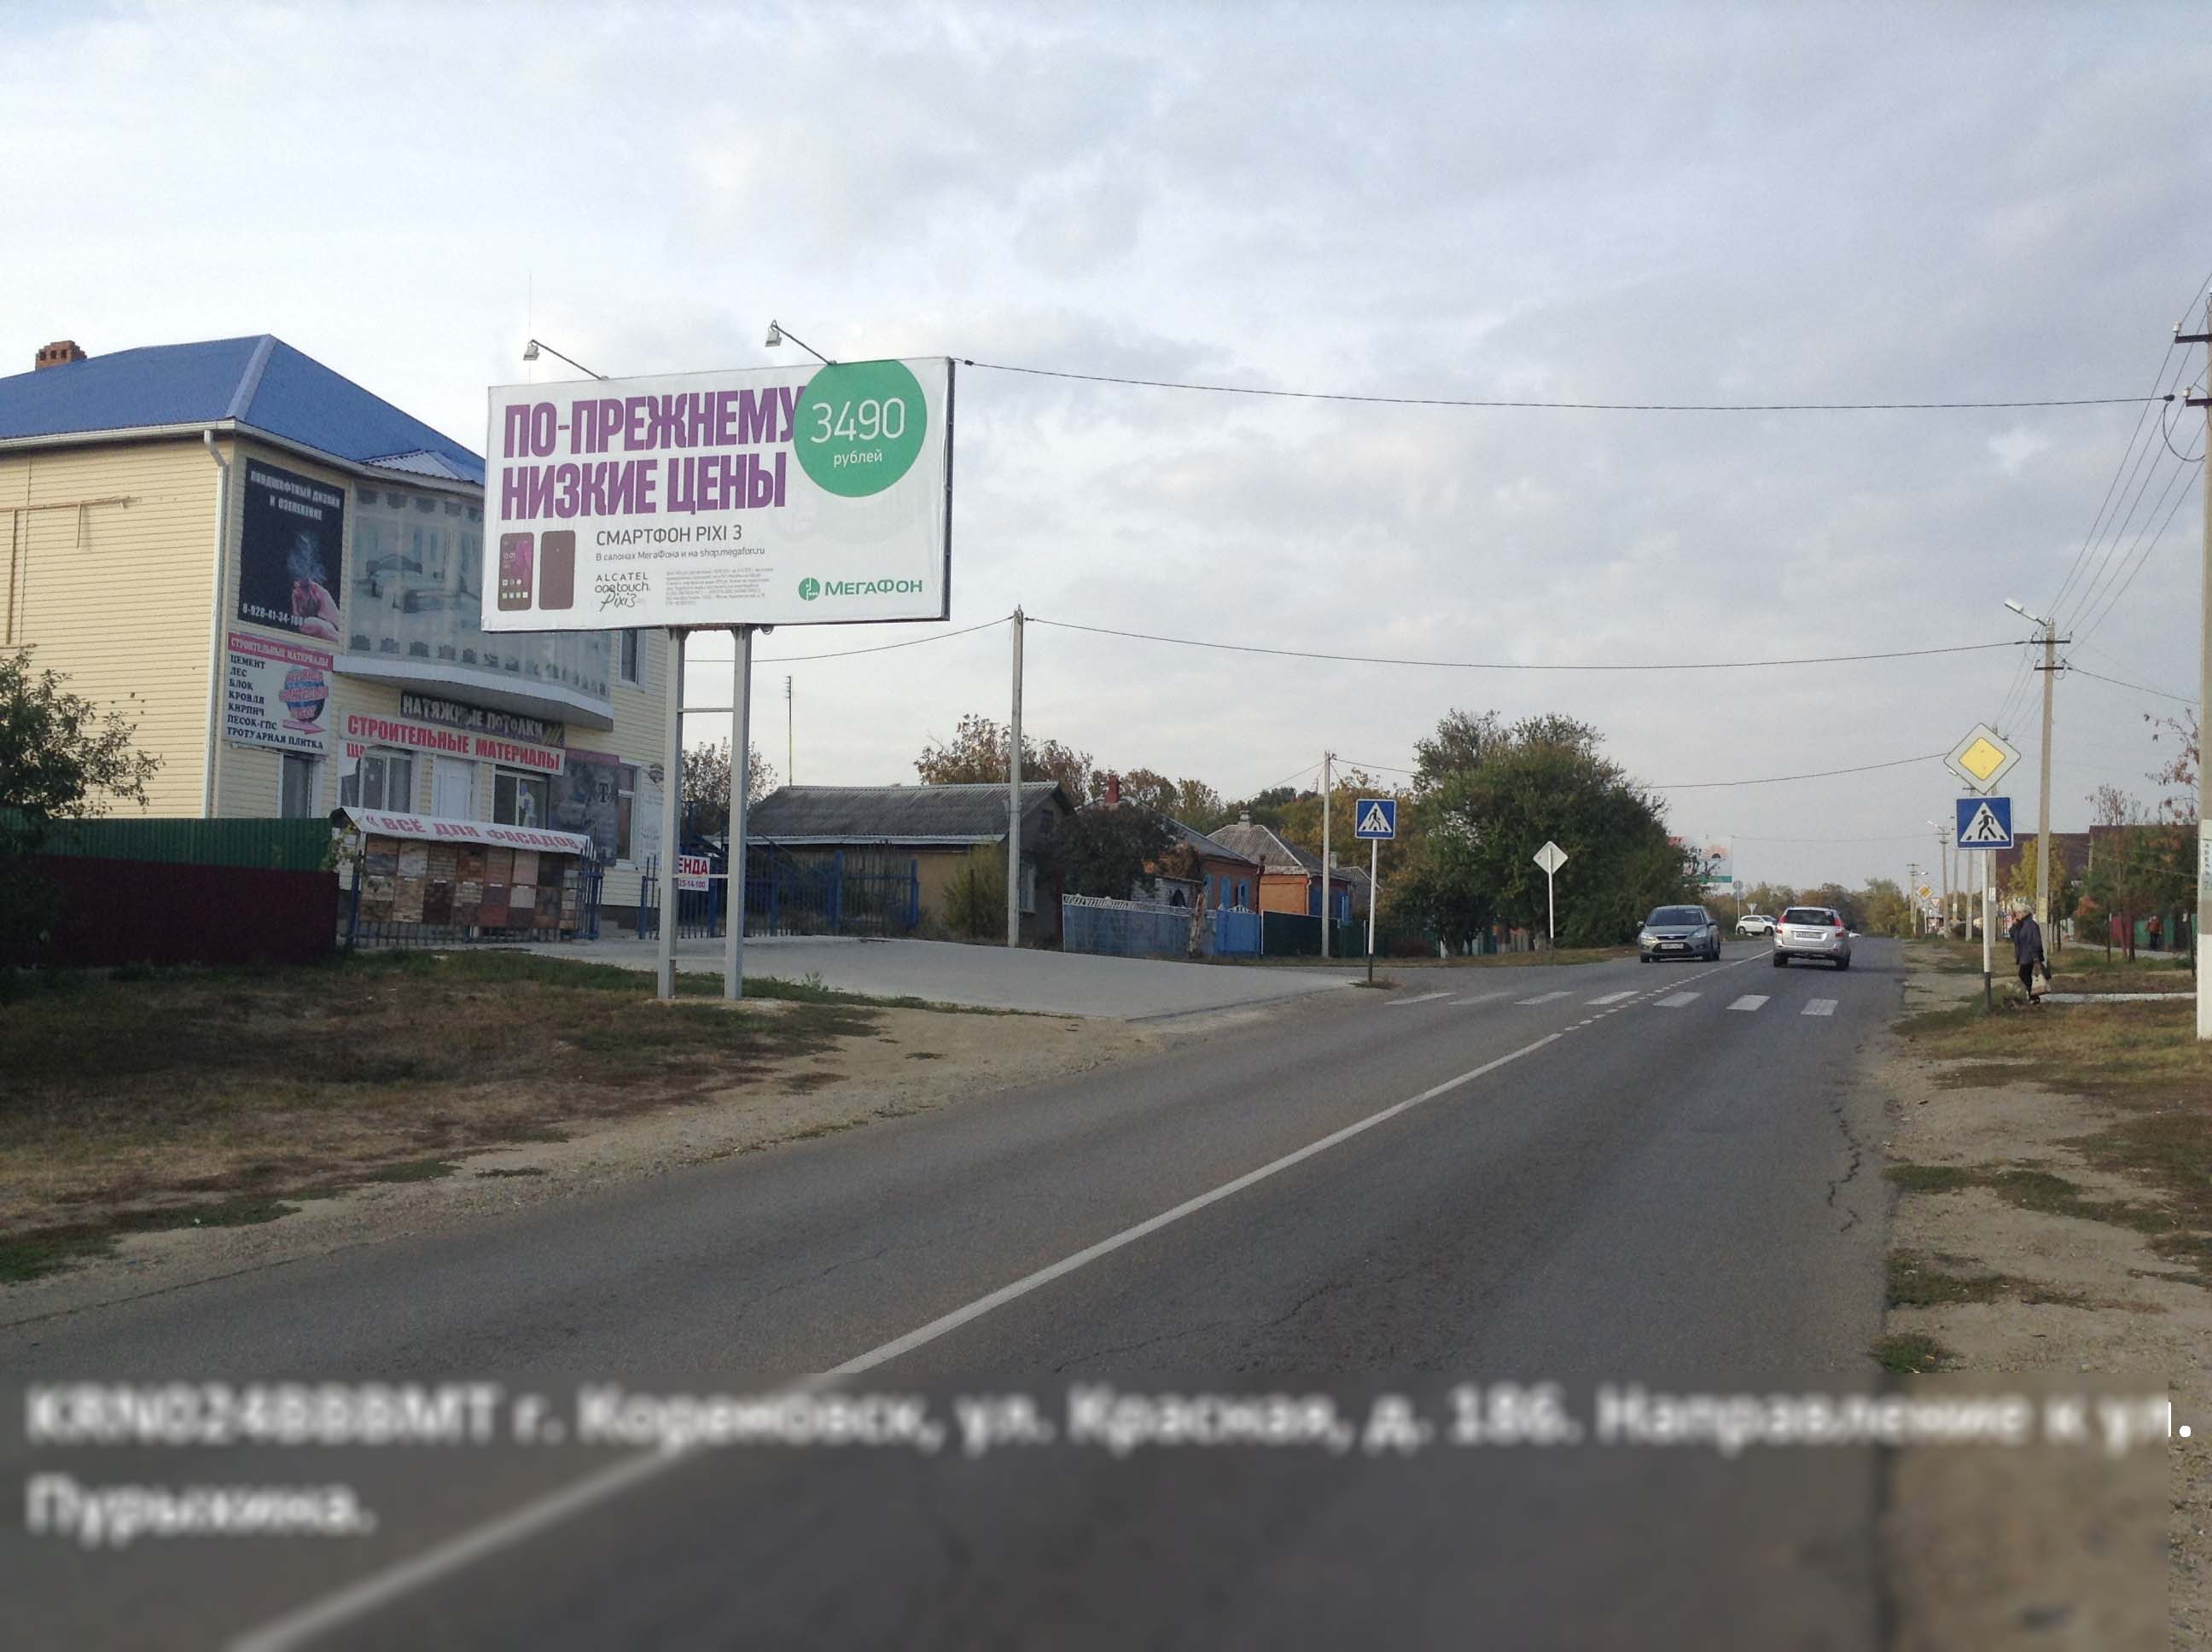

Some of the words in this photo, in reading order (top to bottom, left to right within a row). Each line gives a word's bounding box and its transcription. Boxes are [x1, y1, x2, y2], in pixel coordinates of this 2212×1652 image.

[504, 386, 806, 458] ПО-ПРЕЖНЕМУ
[811, 398, 905, 443] 3490
[833, 449, 882, 468] рублей
[501, 459, 658, 521] НИЗКИЕ
[667, 452, 787, 515] ЦЕНЫ
[597, 526, 690, 546] СМАРТФОН
[696, 525, 727, 542] PIXI
[732, 524, 742, 540] 3
[596, 553, 602, 561] В
[603, 552, 636, 561] салонах
[637, 550, 679, 560] МегаФона
[596, 572, 649, 582] ALCATEL
[230, 654, 265, 670] ЦЕМЕНТ
[230, 666, 247, 678] ЛЕС
[229, 678, 253, 691] БЛОК
[228, 690, 265, 705] КРОВЛЯ
[227, 702, 265, 717] КИРПИЧ
[487, 713, 544, 737] ПОТОЛКИ
[288, 736, 323, 749] ПЛИТКА
[347, 715, 469, 753] СТРОИТЕЛЬНЫЕ
[475, 738, 561, 771] МАТЕРИАЛЫ
[433, 823, 480, 837] ДЛЯ
